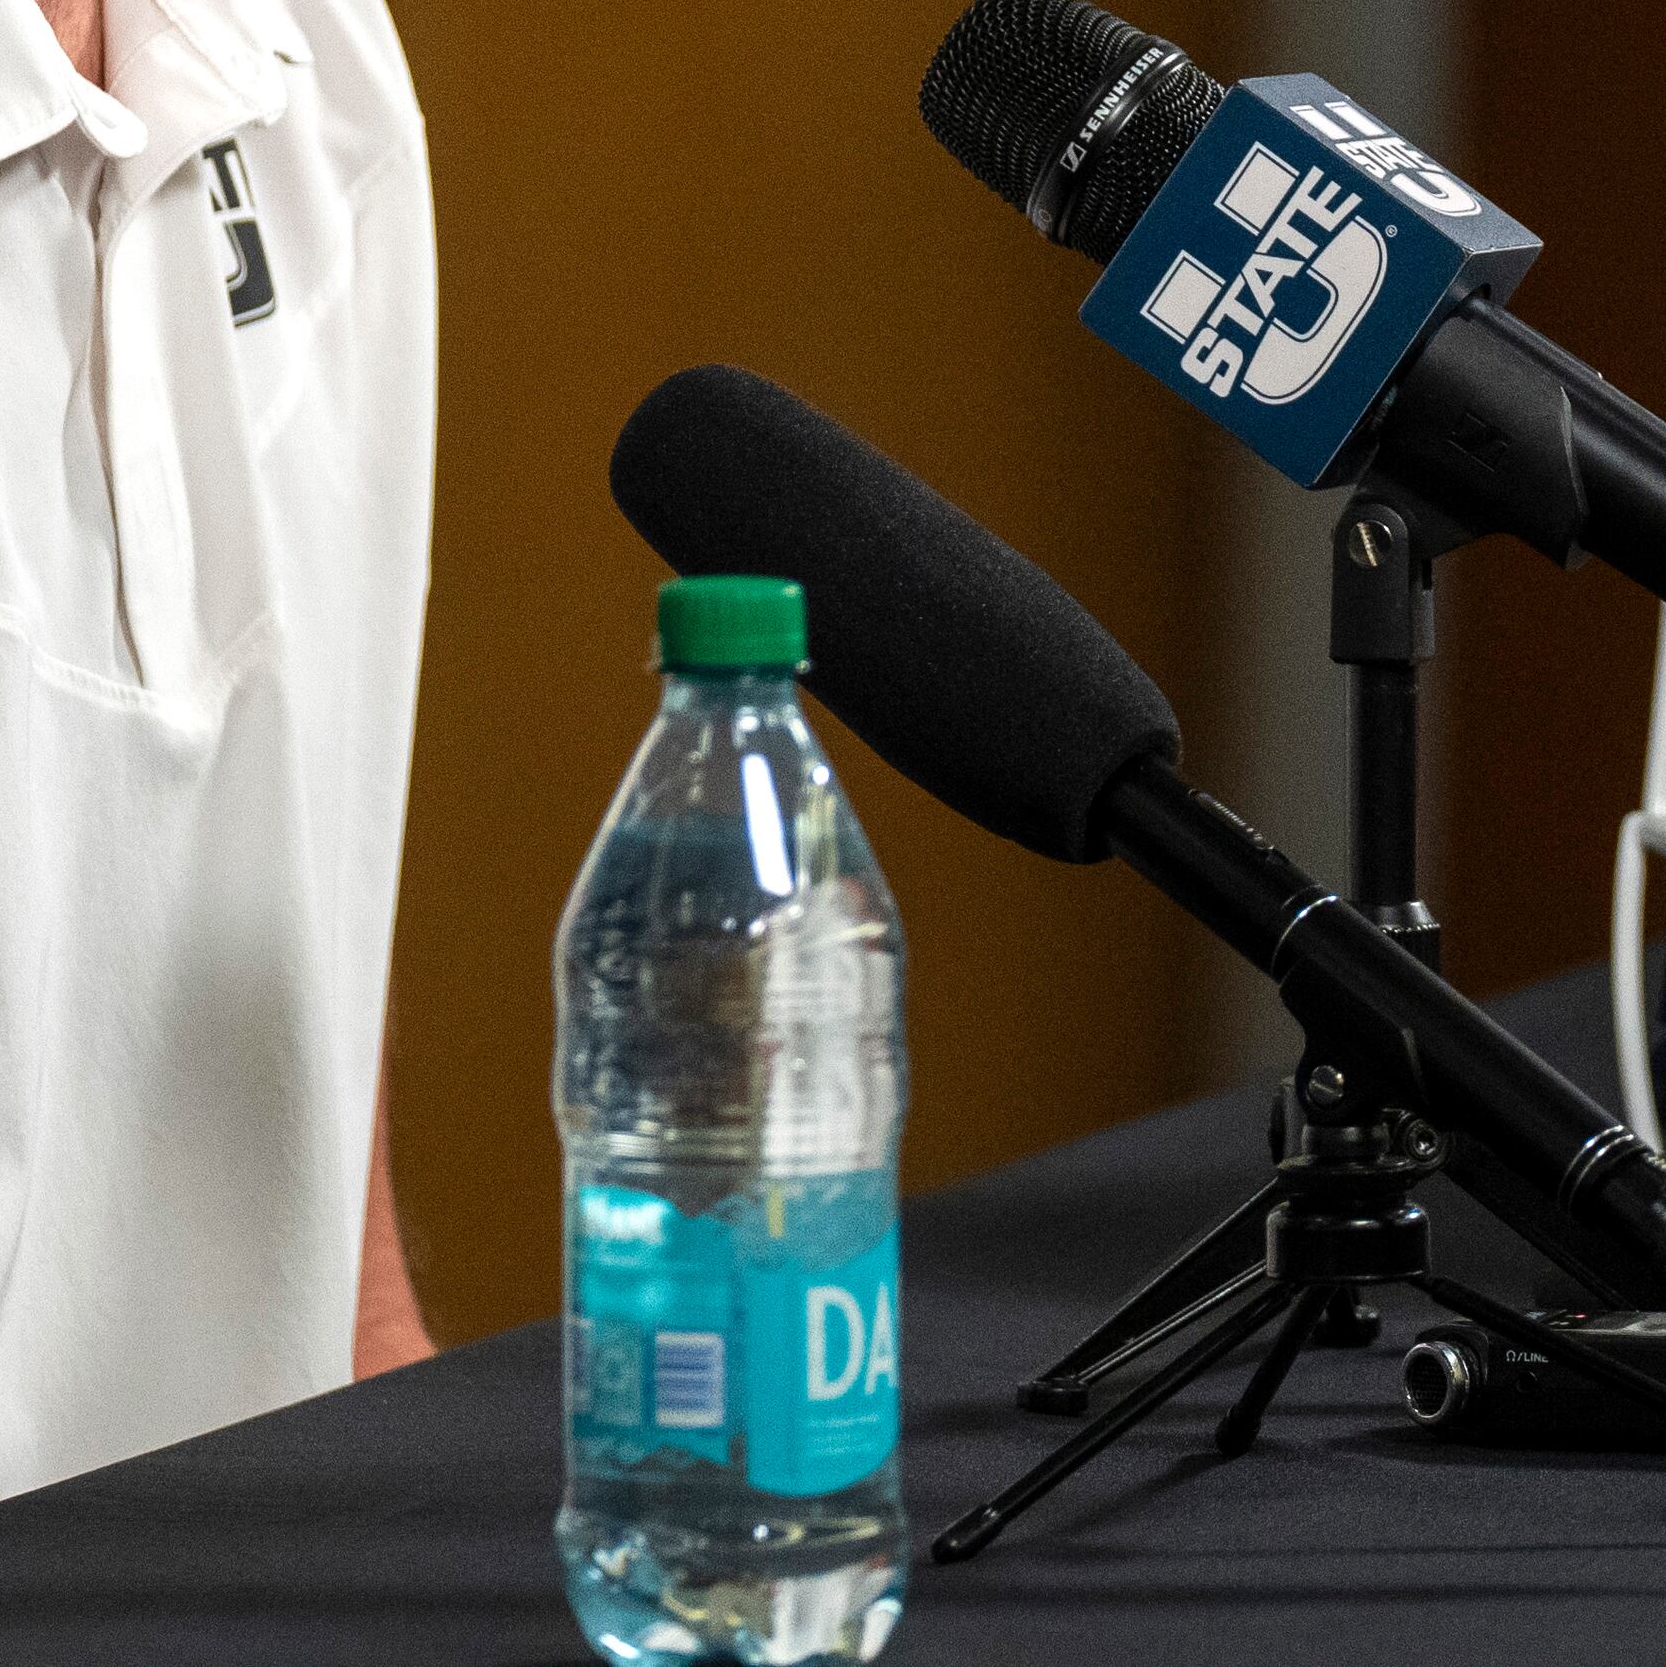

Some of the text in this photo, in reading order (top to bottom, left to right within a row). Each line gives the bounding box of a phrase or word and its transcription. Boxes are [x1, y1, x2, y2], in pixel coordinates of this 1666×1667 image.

[1079, 47, 1164, 143] SENNHEISER
[1335, 136, 1445, 179] STATE
[1180, 165, 1363, 398] STATE
